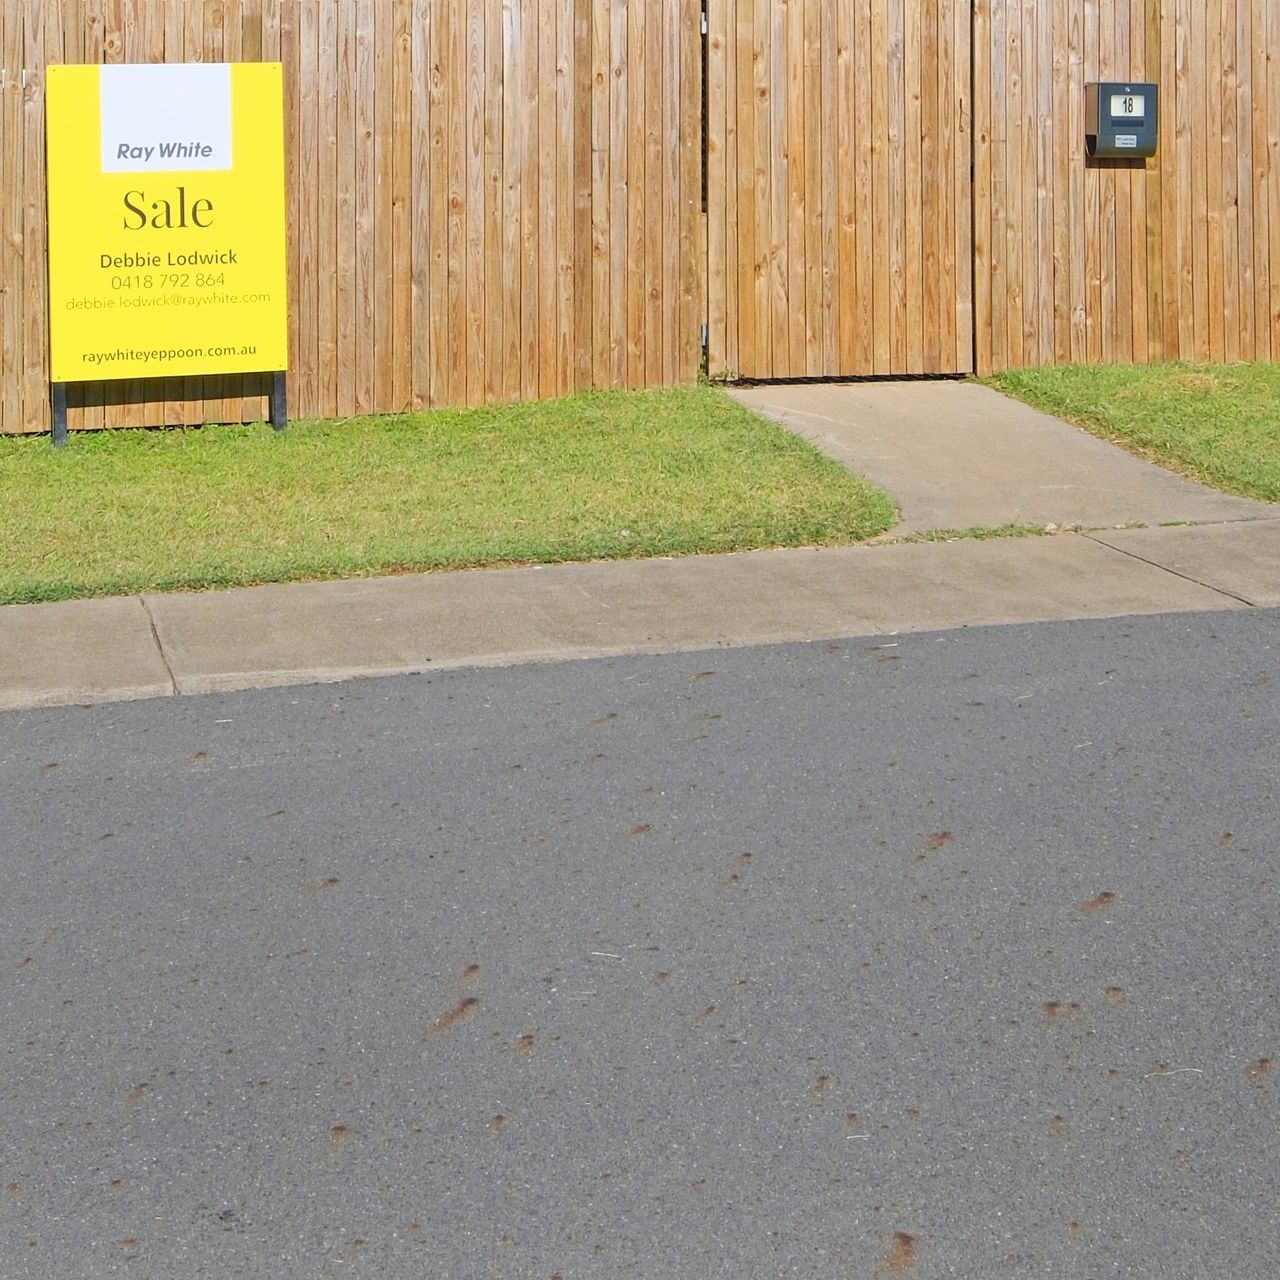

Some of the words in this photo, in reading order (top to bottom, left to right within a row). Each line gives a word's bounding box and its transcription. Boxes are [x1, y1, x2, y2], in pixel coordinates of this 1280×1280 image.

[1123, 97, 1133, 113] 18
[117, 143, 155, 161] Ray
[159, 141, 213, 158] White
[123, 187, 214, 230] Sale
[100, 252, 161, 268] Debbie
[167, 249, 238, 266] Lodwick
[111, 275, 153, 290] 0418
[159, 273, 190, 288] 792
[195, 272, 225, 287] 864
[66, 292, 270, 310] debbie.lodwick@raywhite.com
[82, 345, 257, 364] raywhiteyeppoon.com.au
